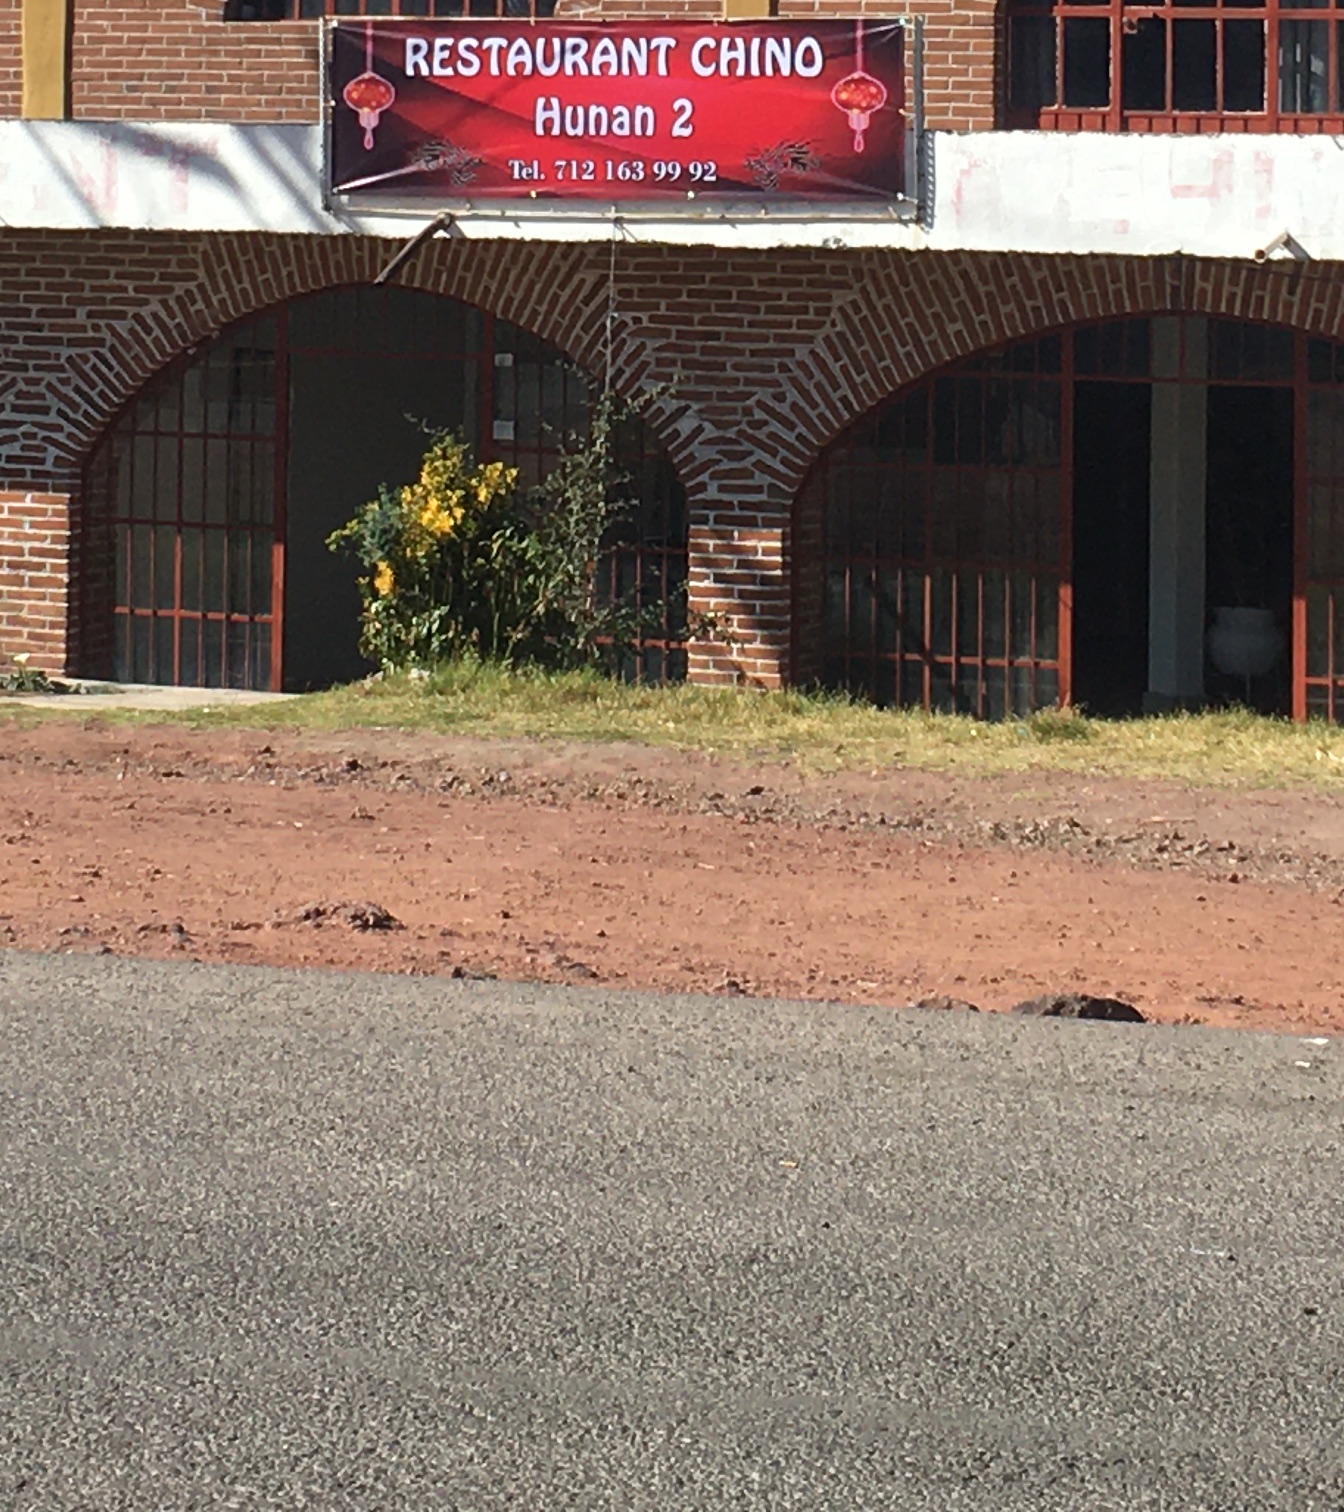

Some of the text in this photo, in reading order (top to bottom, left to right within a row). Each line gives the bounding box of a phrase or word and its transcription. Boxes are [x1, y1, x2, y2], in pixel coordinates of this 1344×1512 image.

[404, 37, 824, 77] RESTAURANT CHINO
[534, 97, 694, 138] Hunan 2
[508, 160, 717, 182] Tel. 712 163 99 92
